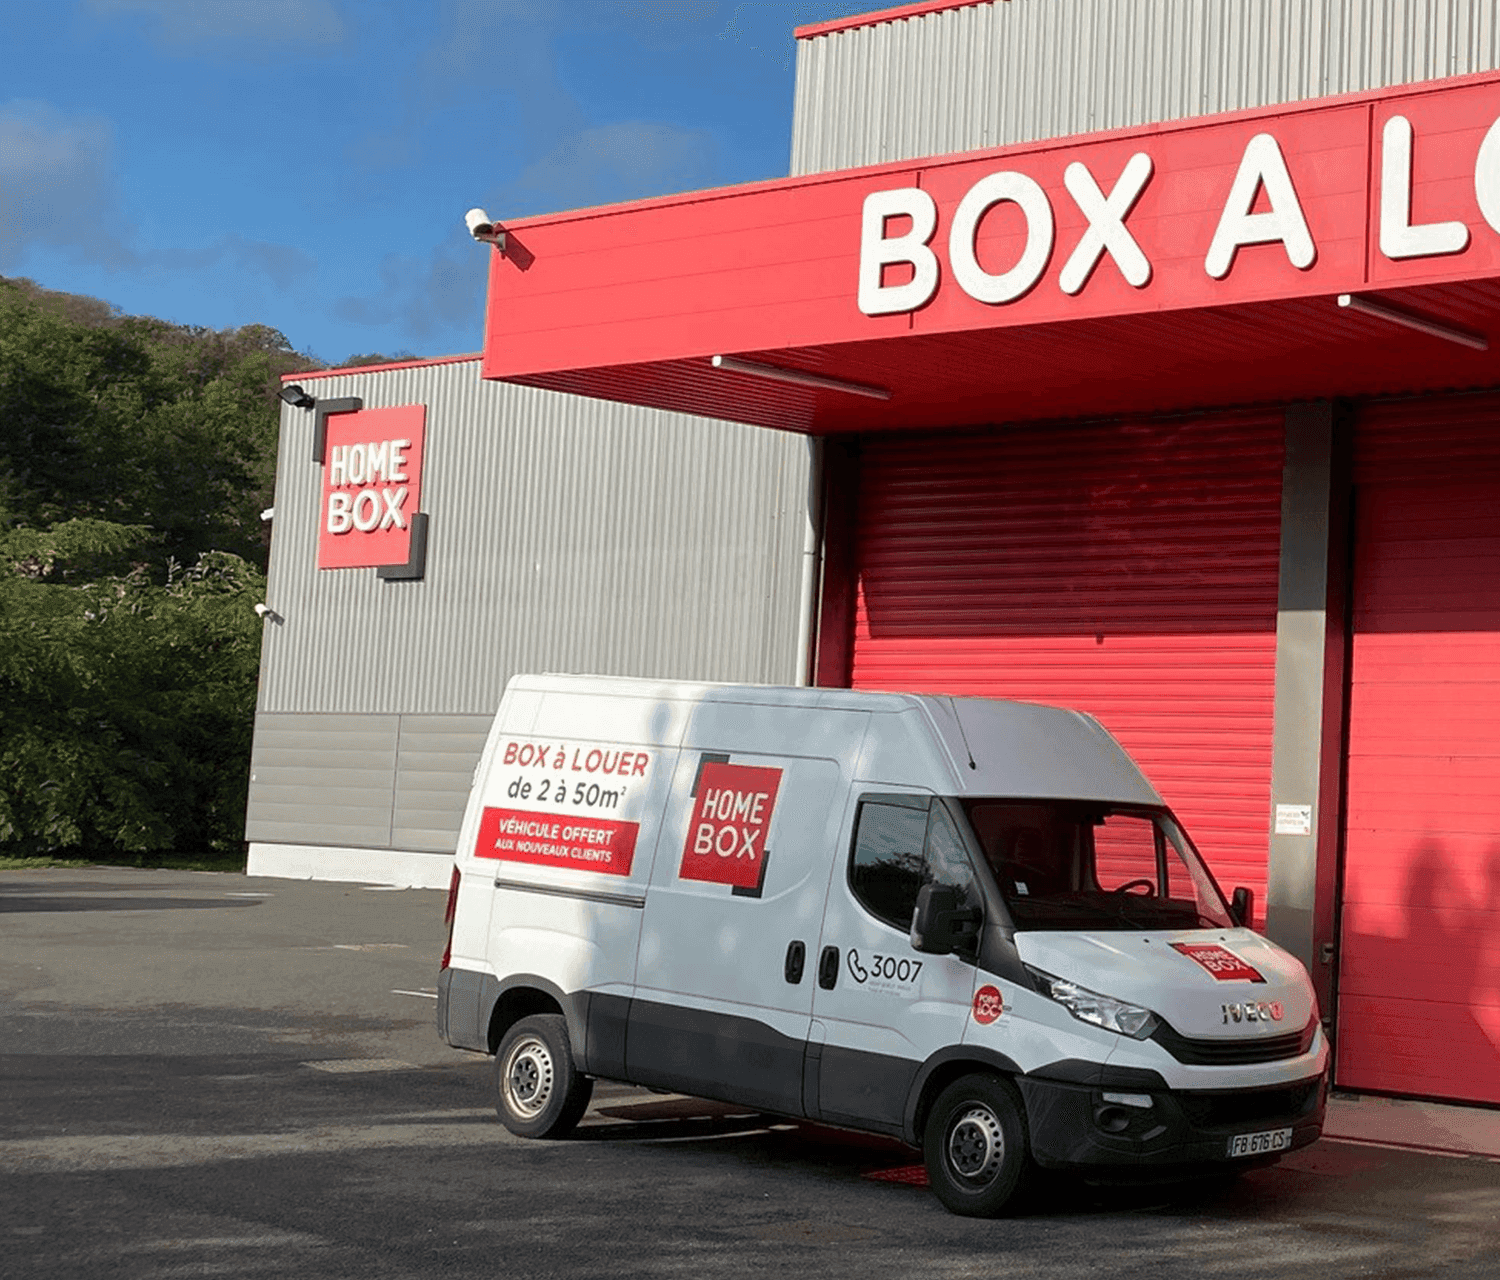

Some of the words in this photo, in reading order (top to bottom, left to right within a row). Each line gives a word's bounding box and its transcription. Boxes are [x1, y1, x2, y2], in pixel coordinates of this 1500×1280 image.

[857, 151, 1154, 316] BOX
[1204, 132, 1317, 281] A
[330, 438, 412, 487] HOME
[327, 486, 409, 534] BOX
[503, 741, 551, 769] BOX
[553, 745, 566, 770] à
[571, 747, 650, 777] LOUER
[507, 775, 532, 800] de
[536, 778, 551, 802] 2
[554, 778, 567, 804] à
[701, 787, 769, 825] HOME
[499, 815, 560, 840] VÉHICULE
[693, 822, 761, 861] BOX
[494, 838, 514, 850] AUX
[515, 840, 569, 858] NOUVEAUX
[570, 847, 613, 863] CLIENTS
[870, 954, 923, 983] 3007
[1203, 959, 1249, 972] BOX
[1221, 1000, 1285, 1025] IVECO
